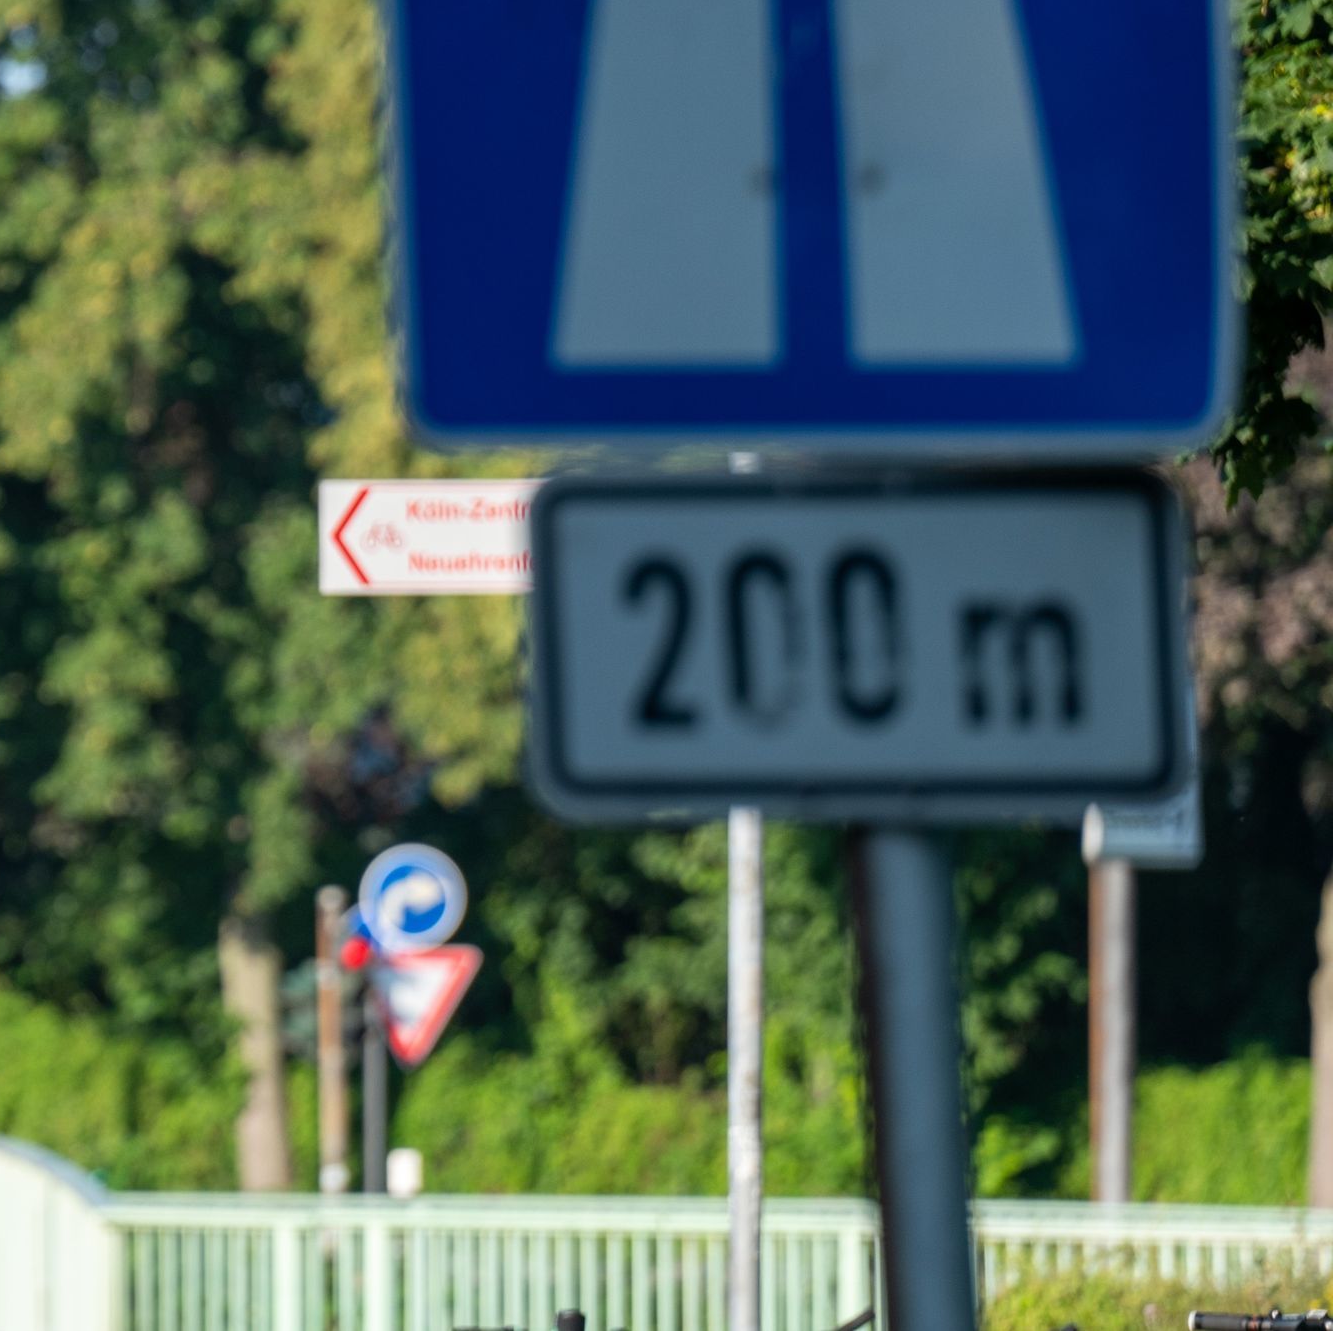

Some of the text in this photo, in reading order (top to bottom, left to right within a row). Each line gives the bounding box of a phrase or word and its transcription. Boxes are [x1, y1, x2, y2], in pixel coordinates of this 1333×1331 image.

[406, 498, 532, 521] Köln-Zentr
[409, 550, 533, 573] Neuehrenf
[621, 543, 1085, 732] 200 m
